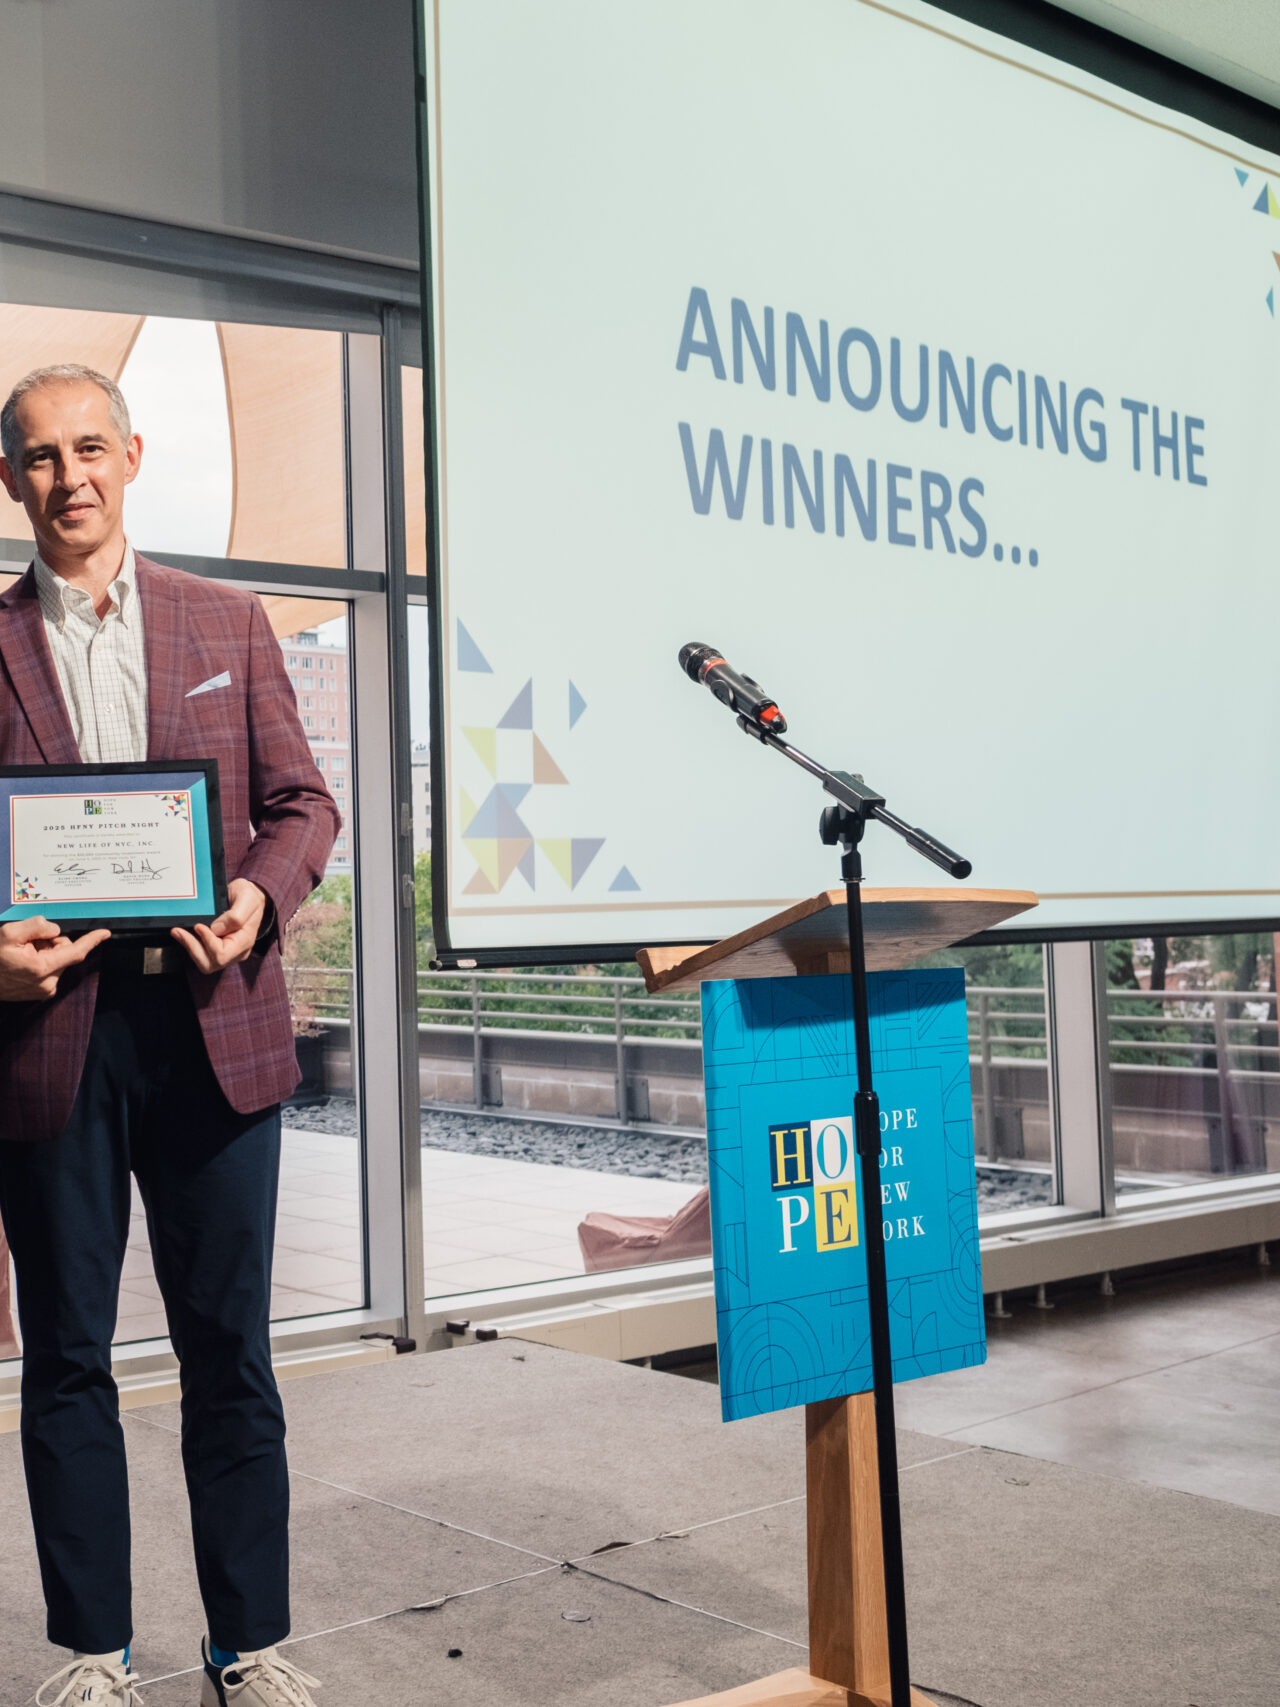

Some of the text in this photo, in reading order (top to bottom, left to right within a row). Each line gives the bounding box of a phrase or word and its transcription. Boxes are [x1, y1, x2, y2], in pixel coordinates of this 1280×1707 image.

[676, 286, 1208, 487] ANNOUNCING THE
[677, 421, 1039, 568] WINNERS...
[879, 1108, 918, 1132] OPE
[879, 1146, 904, 1168] OR
[880, 1181, 910, 1205] EW
[882, 1215, 926, 1241] ORK
